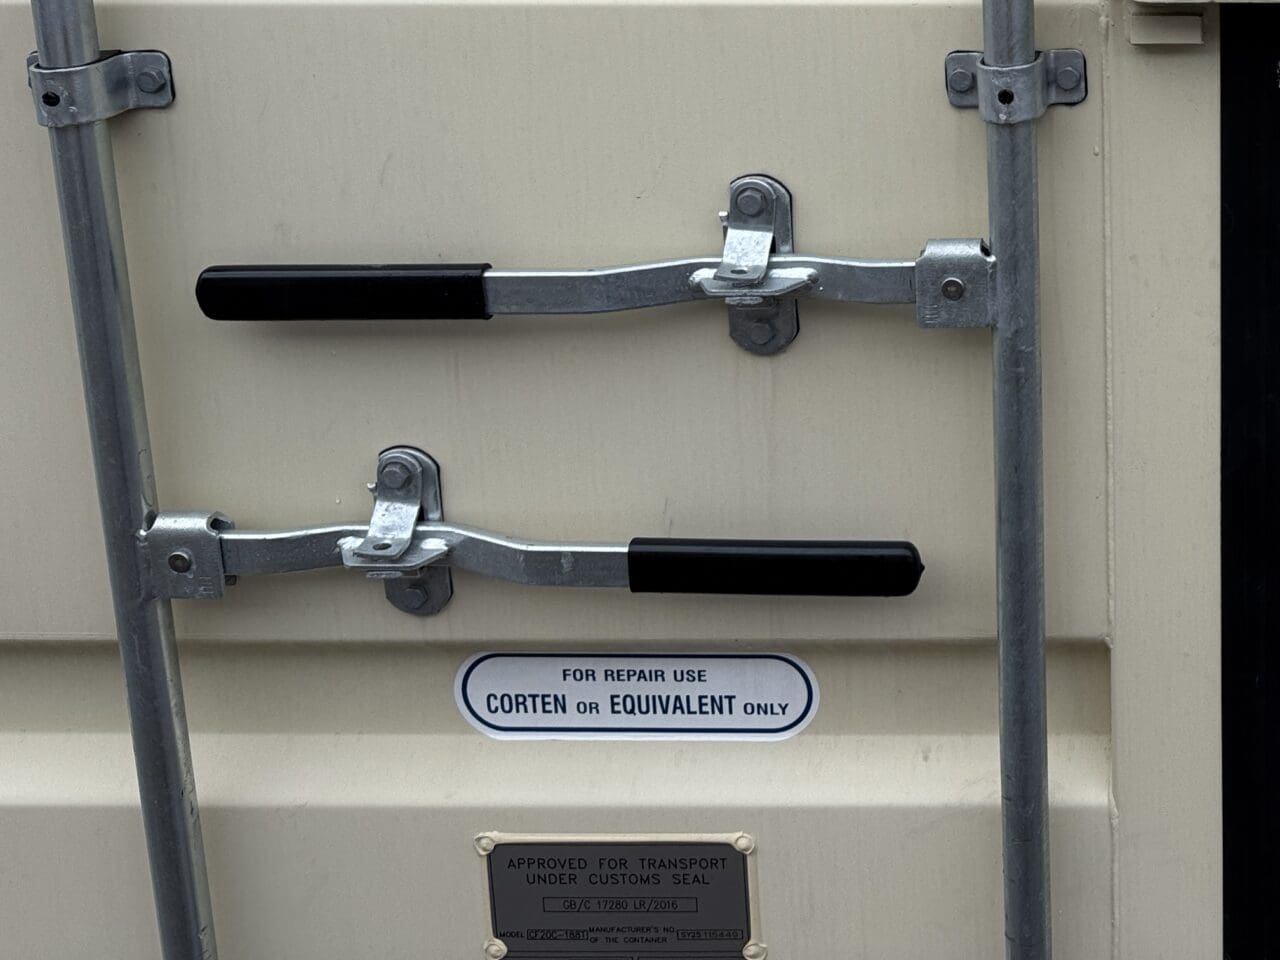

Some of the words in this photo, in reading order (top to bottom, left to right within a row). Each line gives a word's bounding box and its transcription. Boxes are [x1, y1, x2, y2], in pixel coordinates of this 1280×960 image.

[562, 668, 597, 682] FOR
[603, 668, 667, 683] REPAIR
[673, 669, 708, 683] USE
[486, 693, 568, 715] CORTEN
[576, 701, 600, 715] OR
[609, 693, 737, 716] EQUIVALENT
[743, 702, 790, 716] ONLY
[507, 858, 588, 870] APPROVED
[599, 858, 628, 870] FOR
[639, 858, 729, 870] TRANSPORT
[526, 873, 578, 885] UNDER
[588, 873, 661, 885] CUSTOMS
[672, 873, 710, 885] SEAL
